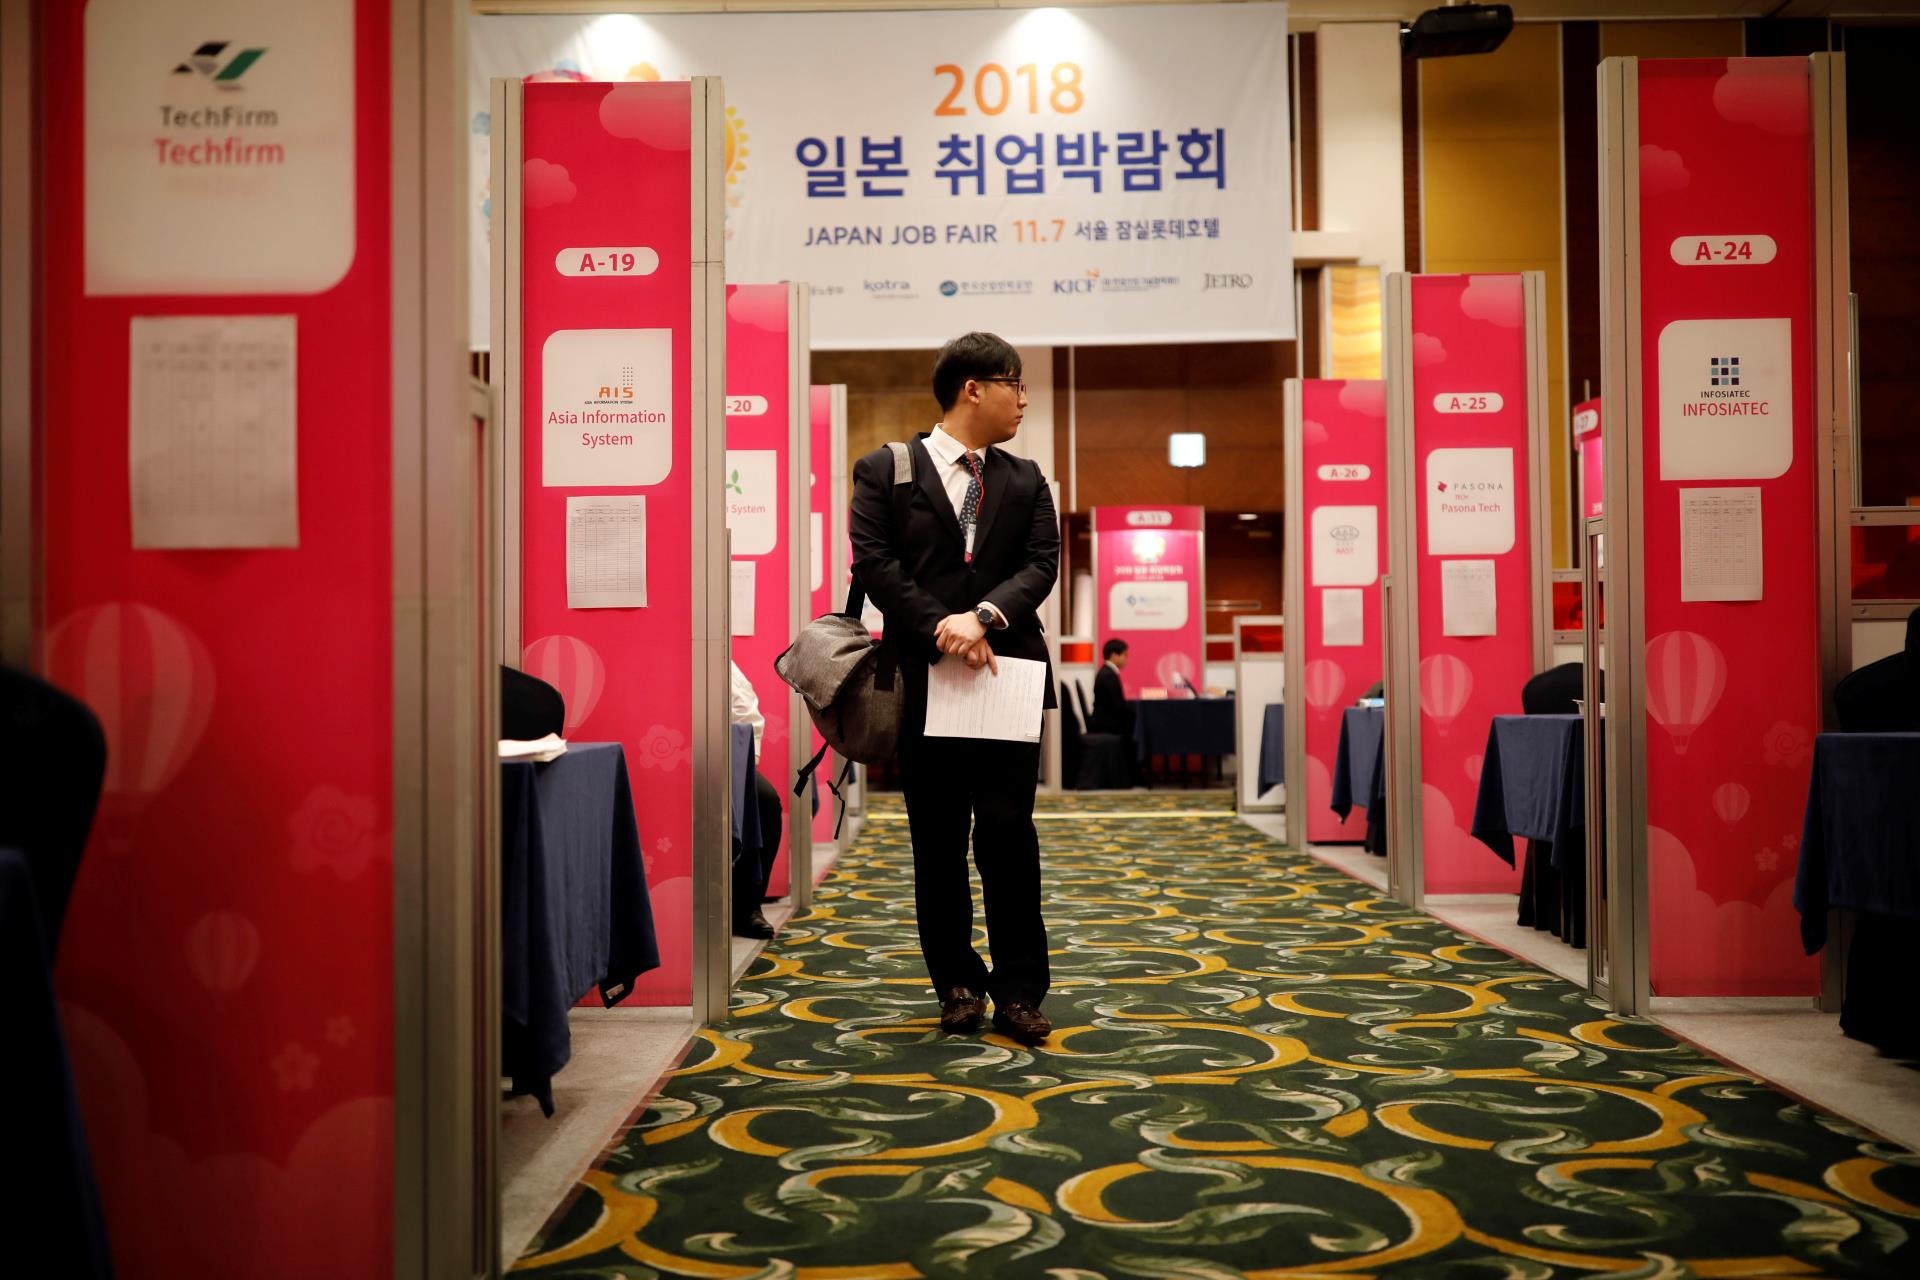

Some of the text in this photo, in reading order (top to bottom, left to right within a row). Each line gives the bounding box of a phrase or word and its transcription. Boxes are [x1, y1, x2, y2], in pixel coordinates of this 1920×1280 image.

[933, 62, 1085, 117] 2018
[160, 105, 278, 127] TechFirm
[154, 137, 284, 165] Techfirm
[797, 128, 1226, 197] 일본 취업박람회
[805, 218, 1220, 246] JAPAN JOB FAIR 11.7 서울 잠실롯데호텔
[1695, 241, 1752, 260] A-24
[579, 253, 635, 272] A-19
[863, 279, 910, 292] kotra
[1201, 273, 1254, 291] JETRO
[599, 386, 633, 398] AIS
[1701, 390, 1750, 398] INFOSIATEC
[727, 400, 752, 412] -20
[1450, 397, 1487, 410] A-25
[1683, 402, 1769, 416] INFOSIATEC
[548, 410, 666, 424] Asia Information
[581, 432, 633, 449] System
[1331, 468, 1359, 478] A-26
[731, 504, 766, 516] System
[1441, 502, 1501, 513] Pasona Tech
